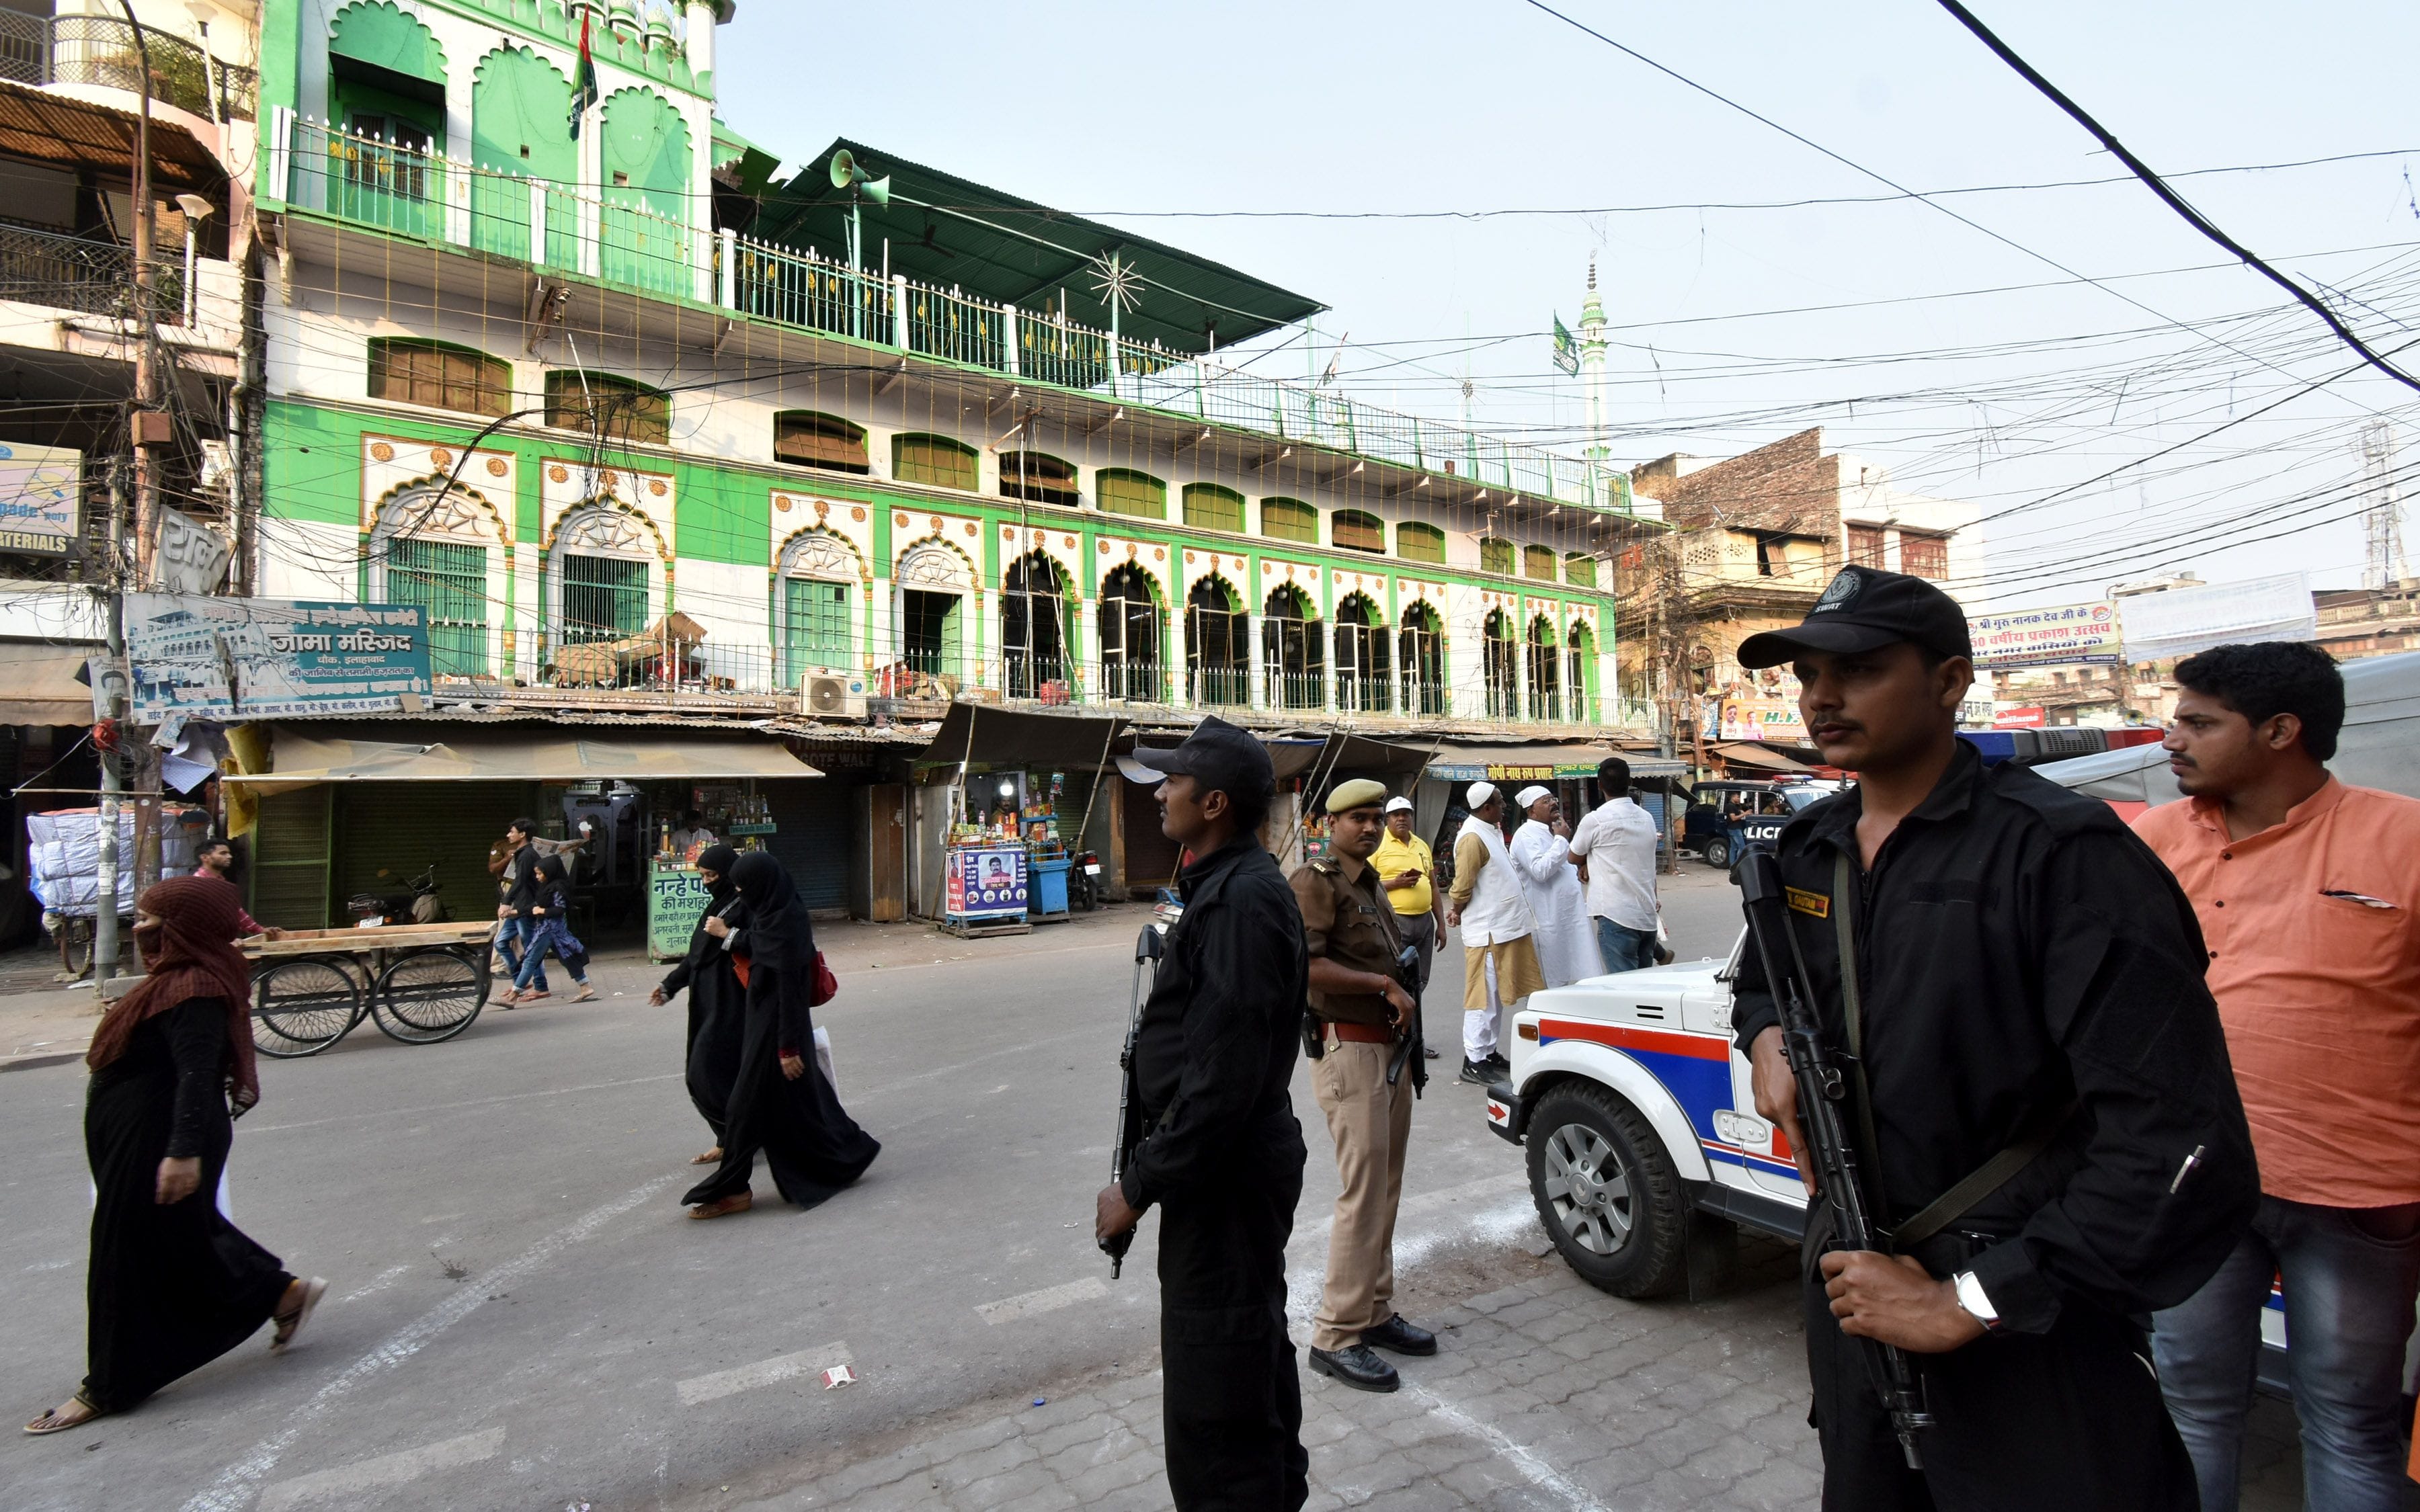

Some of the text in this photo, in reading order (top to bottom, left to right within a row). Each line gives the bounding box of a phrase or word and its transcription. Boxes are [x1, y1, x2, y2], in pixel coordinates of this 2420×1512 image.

[1815, 602, 1842, 613] SWAT
[1980, 607, 2087, 630] श्री गुरु नानक देव जी के
[268, 628, 413, 654] जामा मस्जिद
[1989, 630, 2025, 646] वर्षीय
[2027, 627, 2069, 642] प्रकाश
[2073, 622, 2111, 636] उत्सव
[2083, 636, 2103, 645] को
[288, 667, 302, 678] की
[335, 665, 343, 677] से
[403, 667, 415, 675] का
[1488, 763, 1505, 780] गोपी
[1506, 767, 1521, 780] नाथ
[1534, 767, 1554, 780] प्रसाद
[1744, 827, 1782, 839] LIC
[654, 872, 687, 897] नन्हे
[661, 896, 676, 910] की
